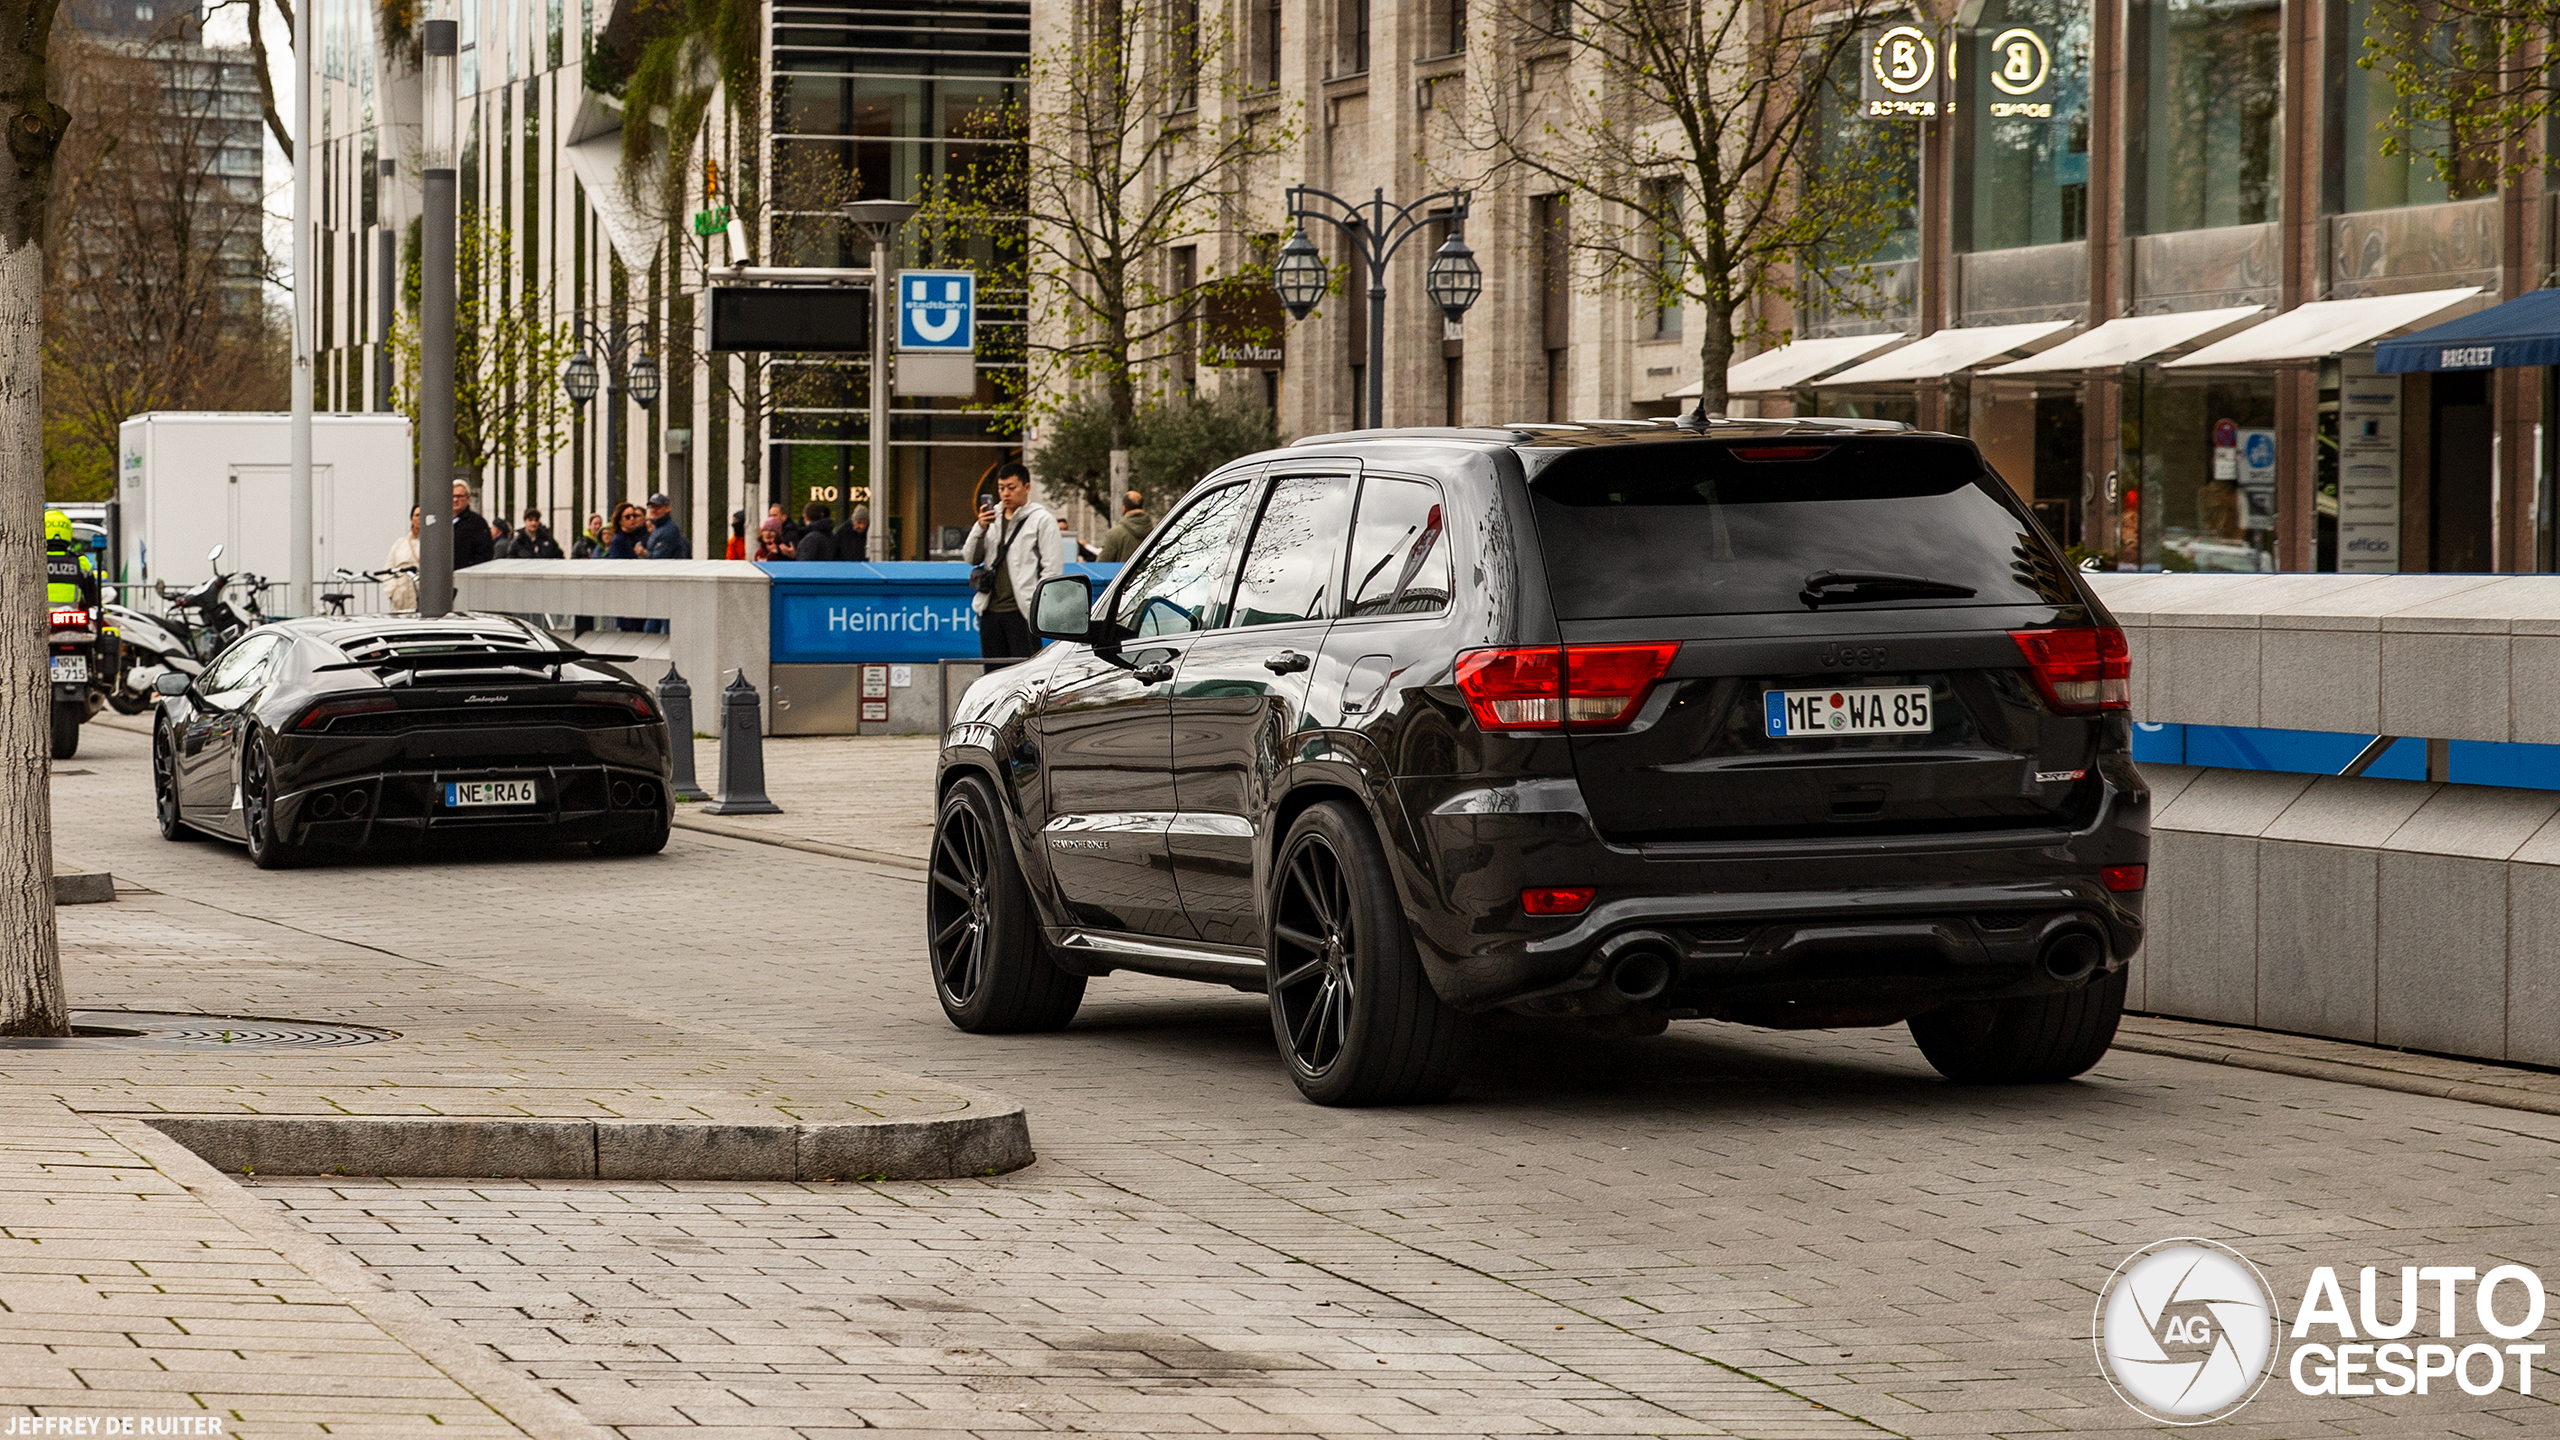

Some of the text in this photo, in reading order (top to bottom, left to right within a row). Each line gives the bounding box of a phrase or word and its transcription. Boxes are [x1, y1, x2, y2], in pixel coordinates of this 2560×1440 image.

[905, 301, 967, 310] stadtbahn
[911, 280, 961, 342] U
[810, 485, 871, 502] ROEX
[46, 562, 77, 575] OLIZEI
[52, 612, 87, 625] BITTE
[1821, 642, 1888, 669] Jeep
[1787, 696, 1826, 730] ME
[1848, 694, 1886, 729] WA
[1893, 693, 1928, 727] 85
[459, 784, 483, 803] NE
[494, 783, 518, 802] RA
